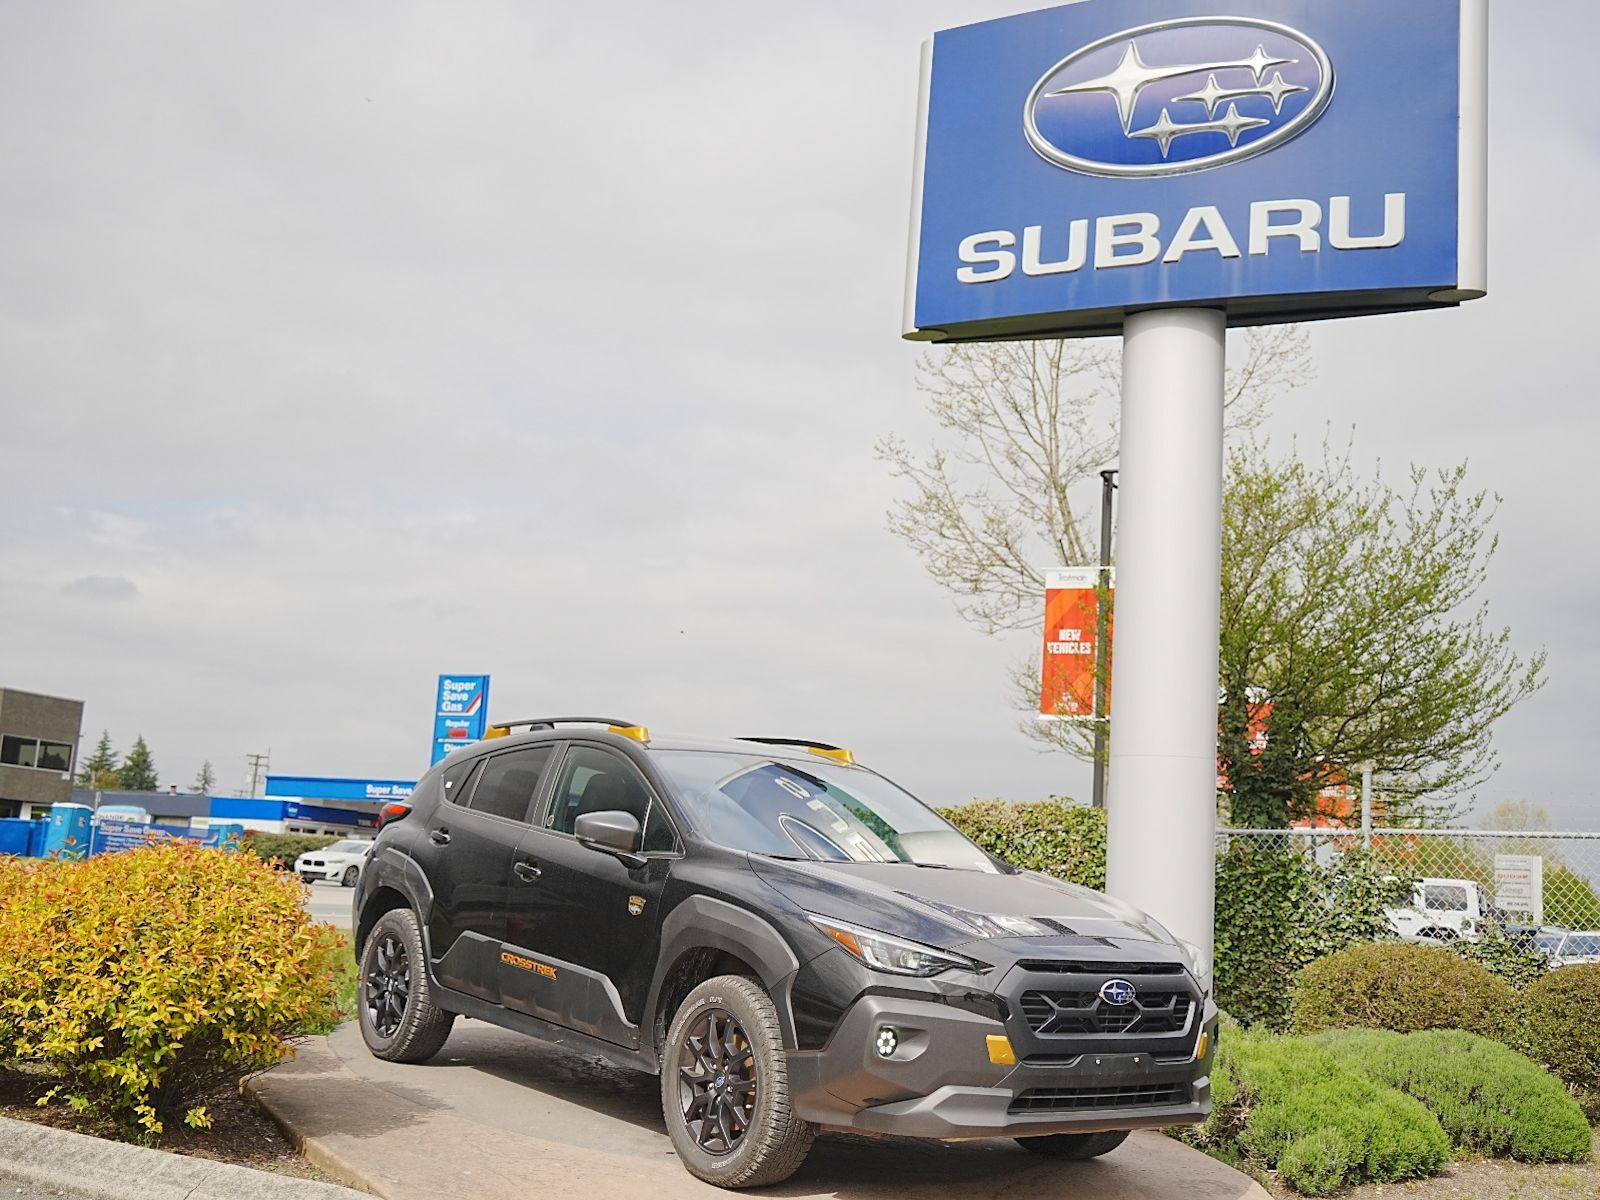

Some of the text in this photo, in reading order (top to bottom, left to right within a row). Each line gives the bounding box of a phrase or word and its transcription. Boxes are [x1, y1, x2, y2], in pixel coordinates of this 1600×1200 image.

[956, 193, 1406, 284] SUBARU
[1059, 629, 1082, 641] NEW
[1047, 642, 1092, 654] VEHICLES
[443, 679, 476, 691] Super
[442, 690, 469, 701] Save
[441, 701, 463, 711] Gas
[366, 784, 412, 795] Super Save
[100, 822, 123, 833] Super
[123, 824, 143, 834] Save
[501, 952, 558, 979] CROSSTREK
